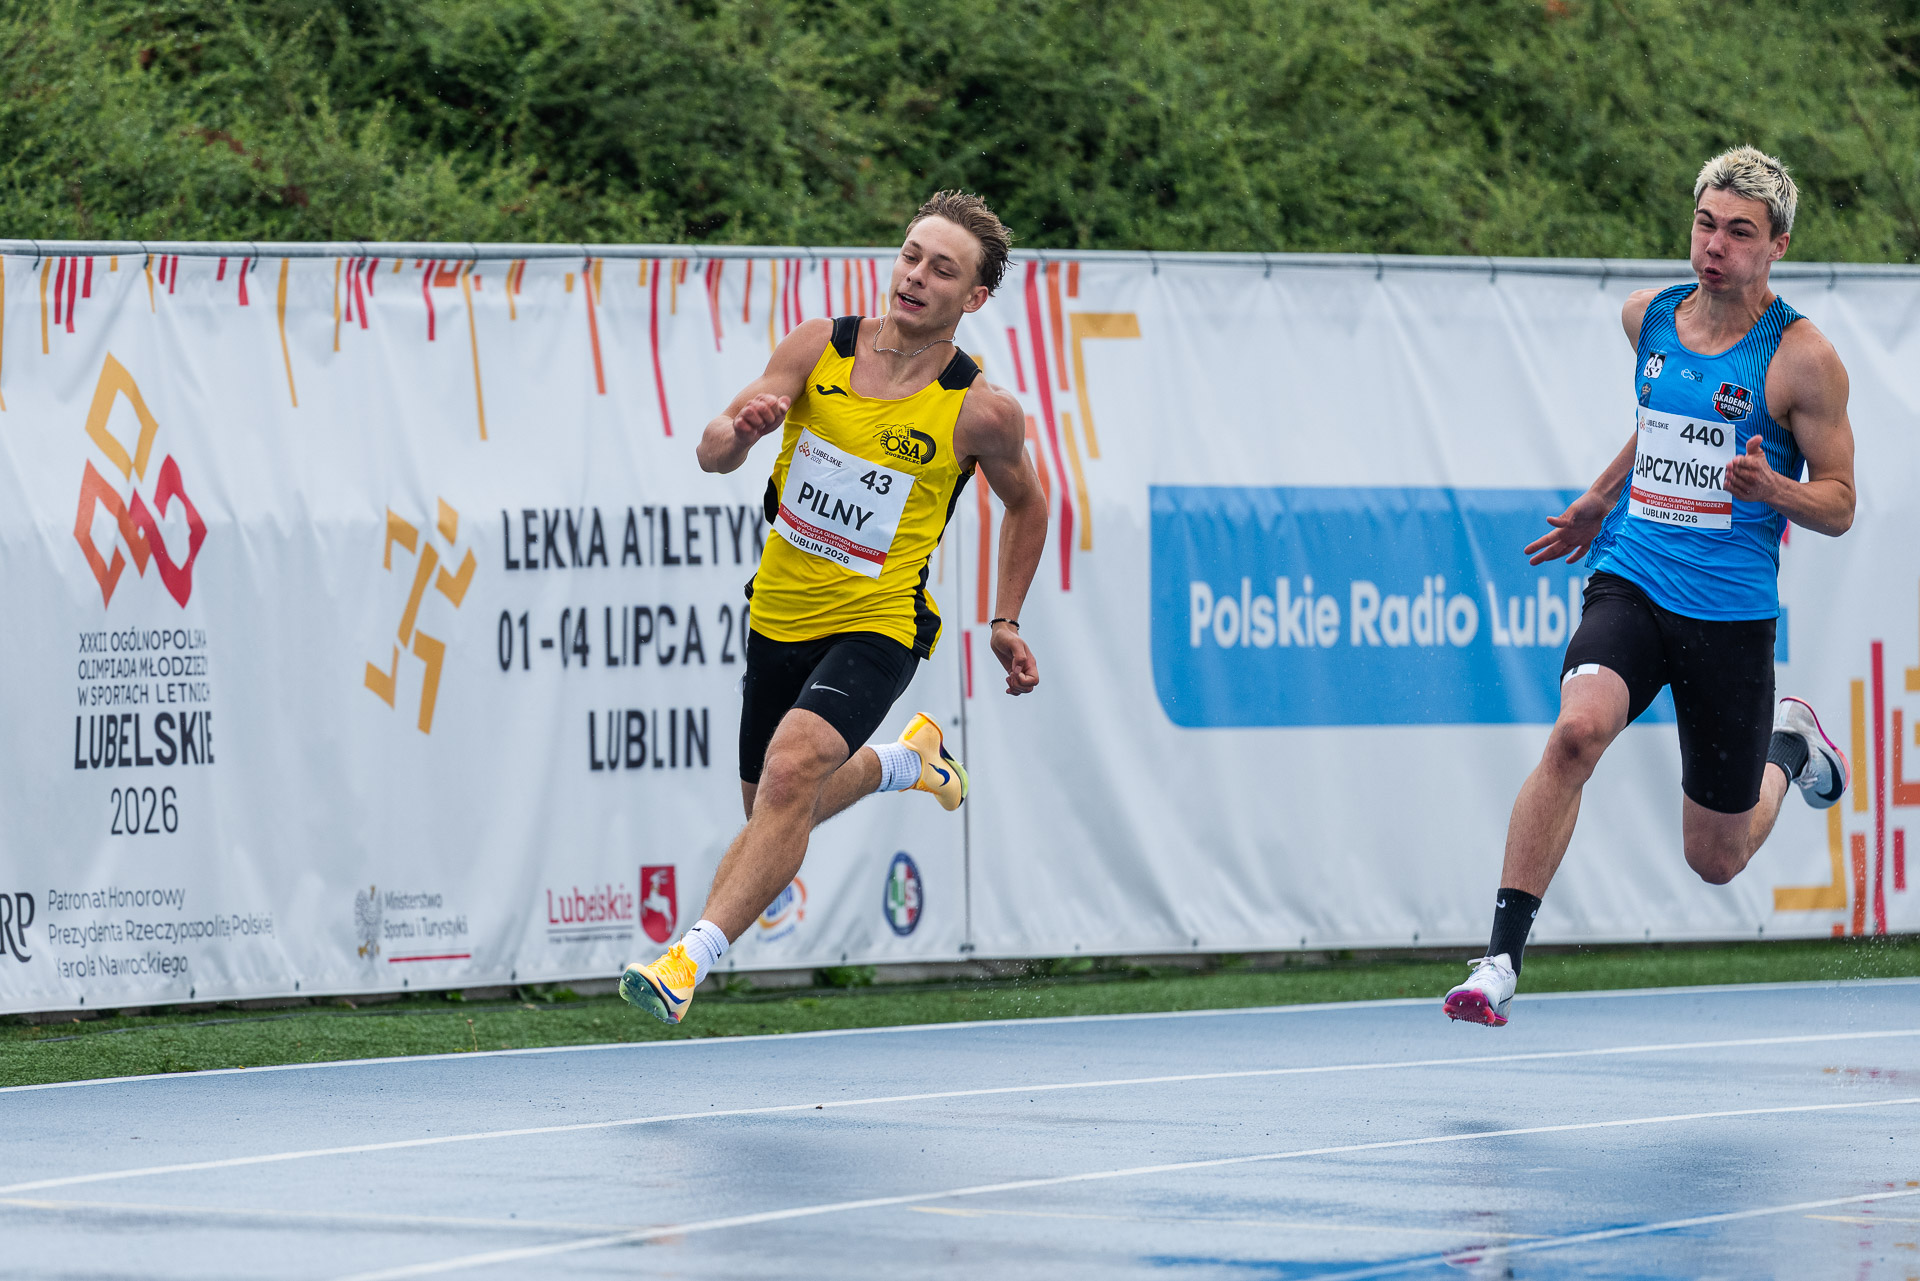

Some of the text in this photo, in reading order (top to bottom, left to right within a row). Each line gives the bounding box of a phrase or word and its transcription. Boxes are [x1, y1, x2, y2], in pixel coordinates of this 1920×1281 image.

[1714, 393, 1753, 412] AKADEMIA
[1720, 403, 1742, 415] SPORTU
[1680, 423, 1724, 447] 440
[810, 454, 822, 465] 2026
[812, 447, 843, 467] LUBELSKIE
[886, 436, 920, 459] OSA
[860, 470, 893, 495] 43
[797, 482, 874, 531] PILNY
[1650, 499, 1674, 509] SPORTACH
[1674, 503, 1695, 511] LETNICH
[1668, 496, 1695, 506] OLIMPIADA
[1642, 507, 1698, 524] LUBLIN 2026
[790, 532, 850, 564] LUBLIN 2026
[801, 528, 829, 542] SPORTACH
[828, 540, 850, 552] LETNICH
[824, 531, 851, 547] OLIMPIADA
[1190, 574, 1590, 649] Polskie Radio Lubl
[79, 632, 107, 653] XXXII
[605, 605, 706, 668] LIPCA
[78, 658, 136, 680] OLIMPIADA
[77, 686, 88, 707] W
[91, 684, 149, 706] SPORTACH
[74, 711, 215, 770] LUBELSKIE
[589, 708, 709, 771] LUBLIN
[110, 786, 178, 835] 2026
[48, 887, 186, 911] Patronat Honorowy
[547, 884, 633, 924] Lubelskie
[48, 919, 123, 948] Prezydenta
[54, 951, 188, 978] Karola Nawrockiego
